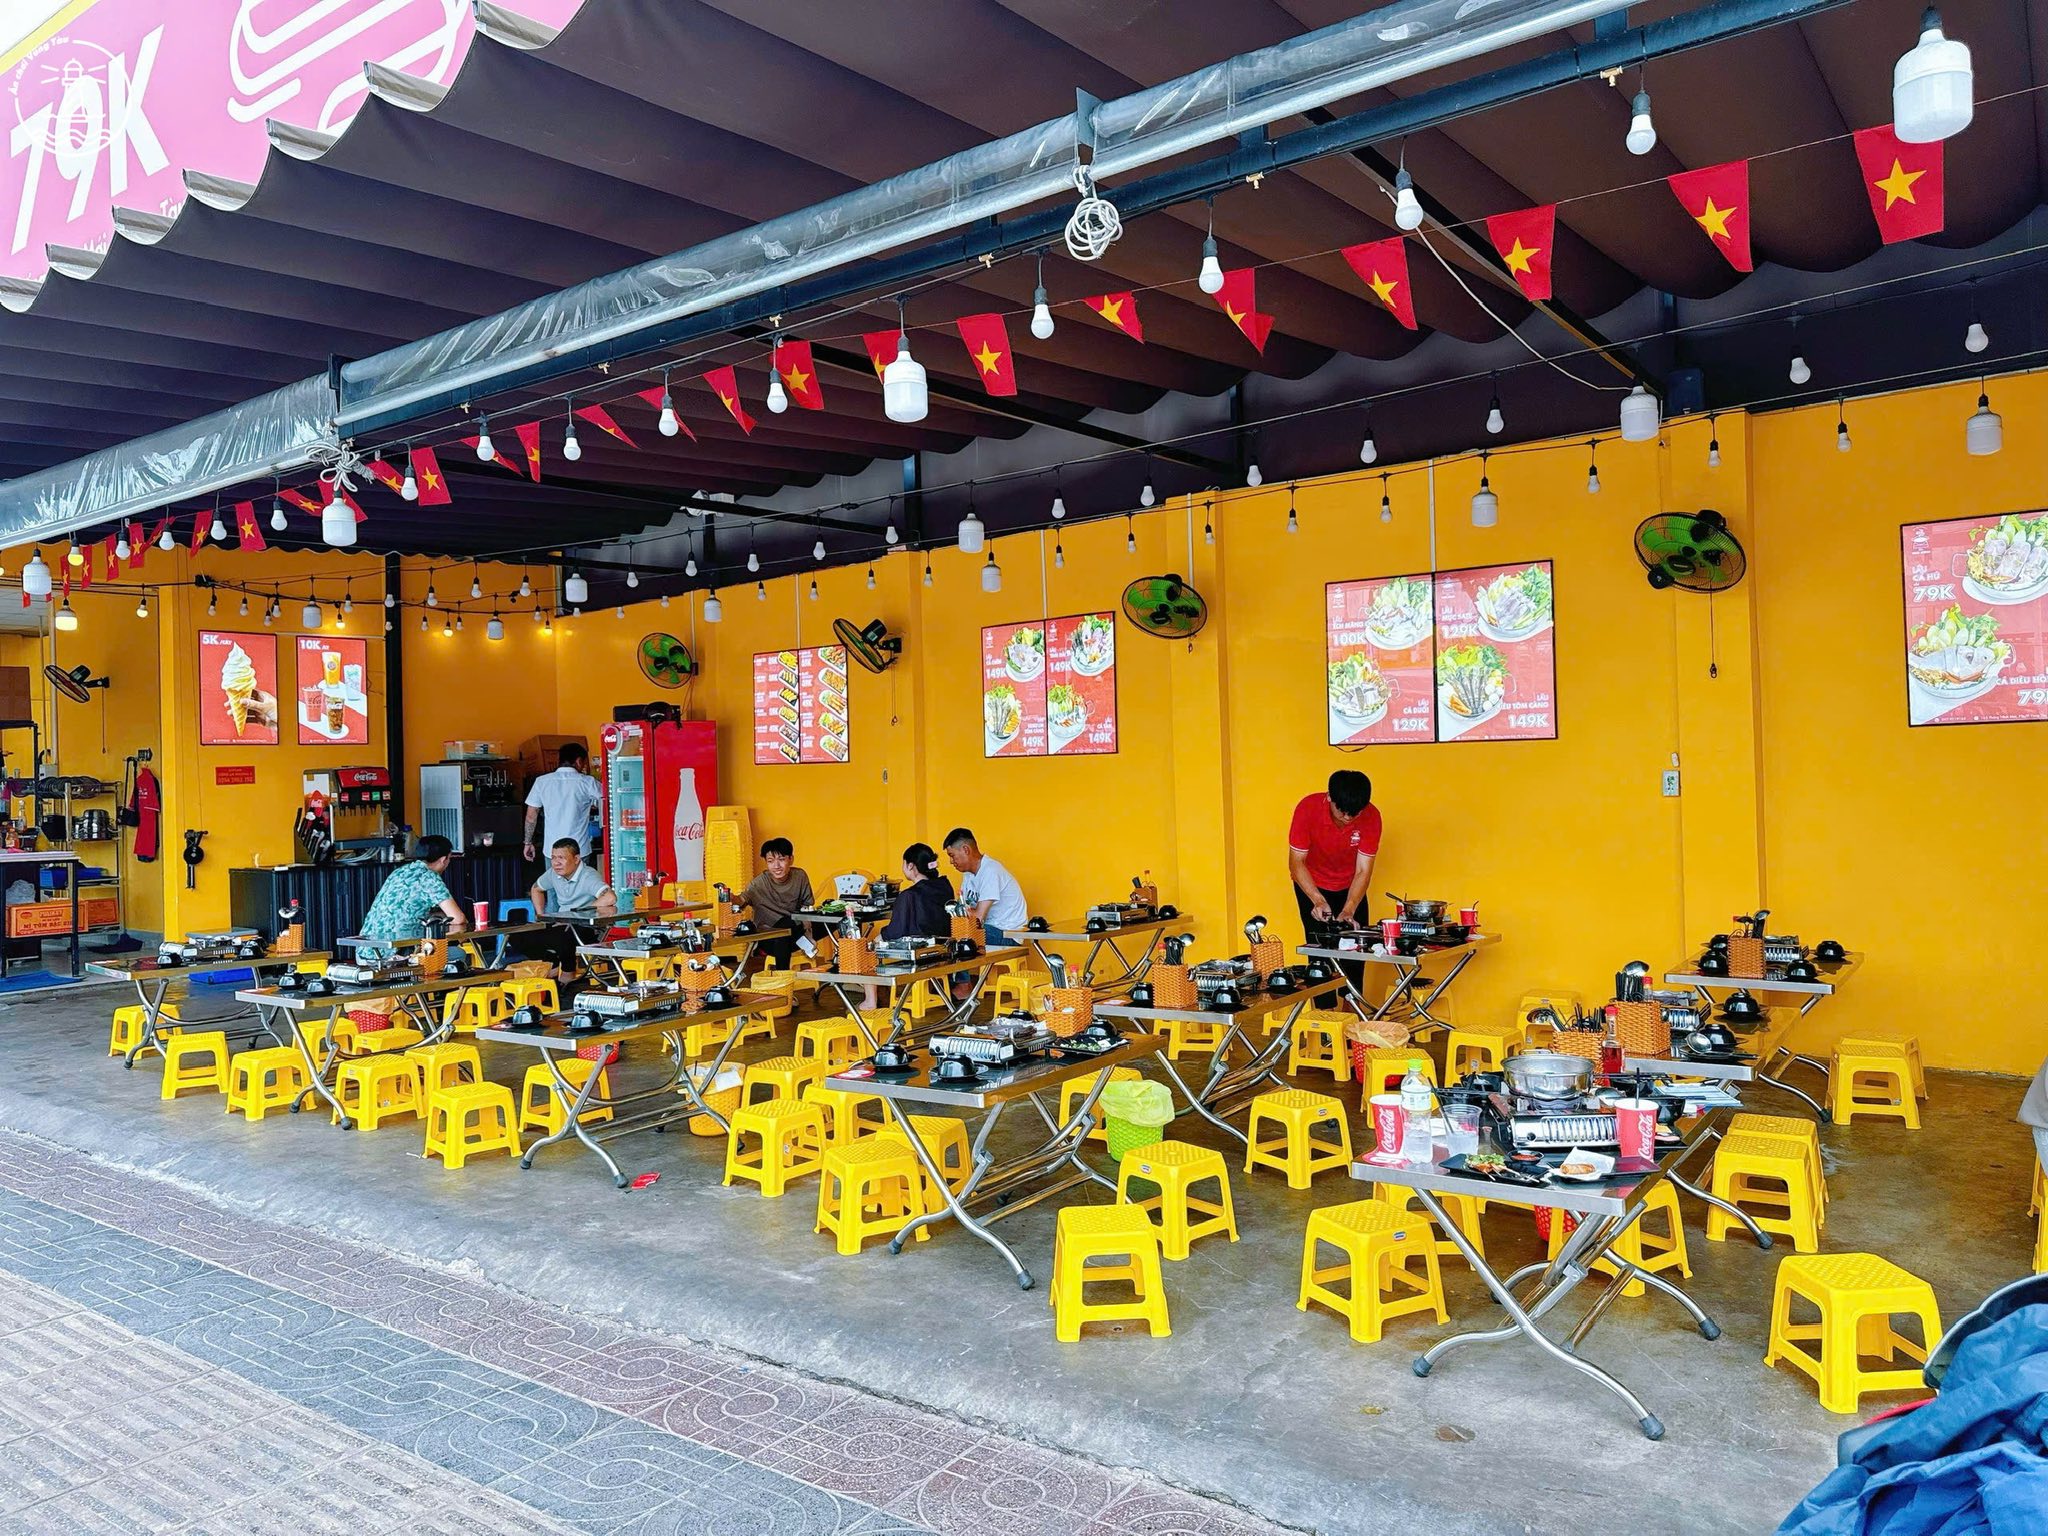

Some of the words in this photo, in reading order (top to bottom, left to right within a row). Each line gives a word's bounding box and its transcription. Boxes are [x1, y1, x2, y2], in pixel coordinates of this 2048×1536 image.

[10, 24, 171, 256] 79K
[1912, 583, 1957, 603] 79K
[1441, 622, 1480, 639] 129K
[203, 633, 219, 645] 5K
[301, 639, 321, 650] 10K
[2017, 687, 2048, 706] 79
[1392, 717, 1430, 732] 129K
[1508, 712, 1550, 728] 149K
[1023, 736, 1044, 748] 149K
[1089, 732, 1113, 744] 149K
